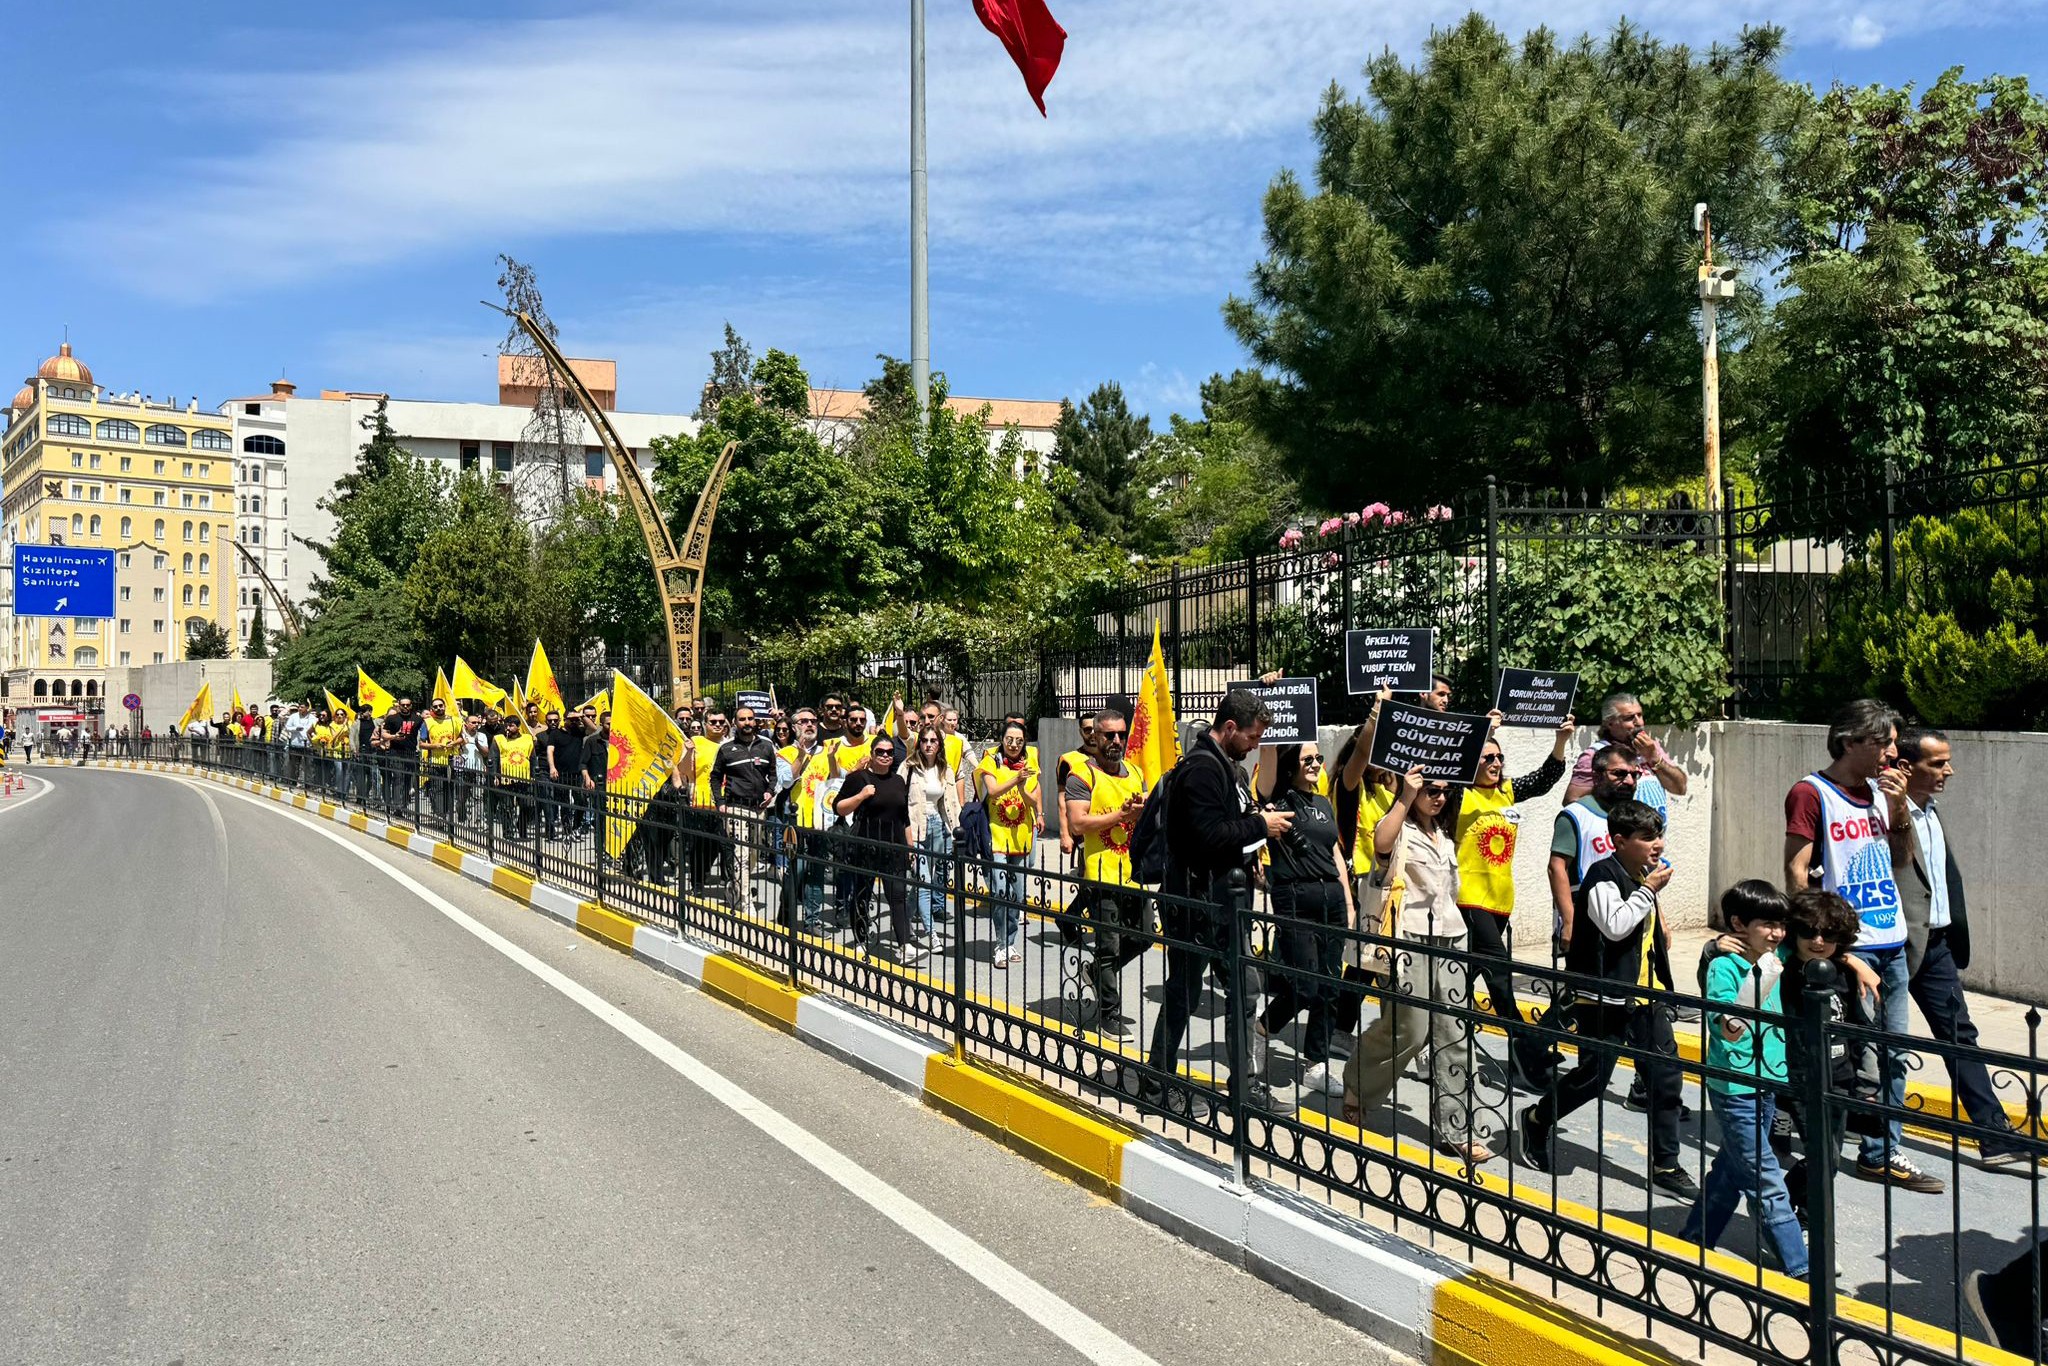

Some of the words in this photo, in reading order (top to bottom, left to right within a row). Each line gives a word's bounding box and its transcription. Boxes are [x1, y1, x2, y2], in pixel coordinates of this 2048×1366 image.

[22, 554, 94, 565] Havalimanı
[22, 566, 78, 577] Kızıltepe
[22, 577, 80, 587] Şanlıurfa
[1365, 634, 1411, 646] ÖFKELİYİZ,
[1368, 649, 1408, 659] YASTAYIZ
[1361, 663, 1386, 674] YUSUF
[1387, 661, 1416, 672] TEKİN
[1373, 674, 1399, 686] İSTİFA
[1531, 676, 1555, 687] ÖNLÜK
[1287, 683, 1312, 695] DEĞİL
[1509, 689, 1535, 698] SORUN
[1533, 689, 1568, 700] ÇÖZMÜYOR
[1264, 700, 1294, 711] RIŞÇIL
[1516, 702, 1556, 711] OKULLARDA
[1273, 712, 1297, 724] ĞİTİM
[1391, 710, 1474, 734] ŞİDDETSİZ,
[1522, 712, 1565, 724] İSTEMİYORUZ
[1261, 726, 1299, 739] ZÜMDÜR
[1396, 728, 1465, 747] GÜVENLİ
[1391, 742, 1462, 762] OKULLAR
[1384, 753, 1462, 776] İSTİORUZ
[1873, 912, 1896, 925] 1995
